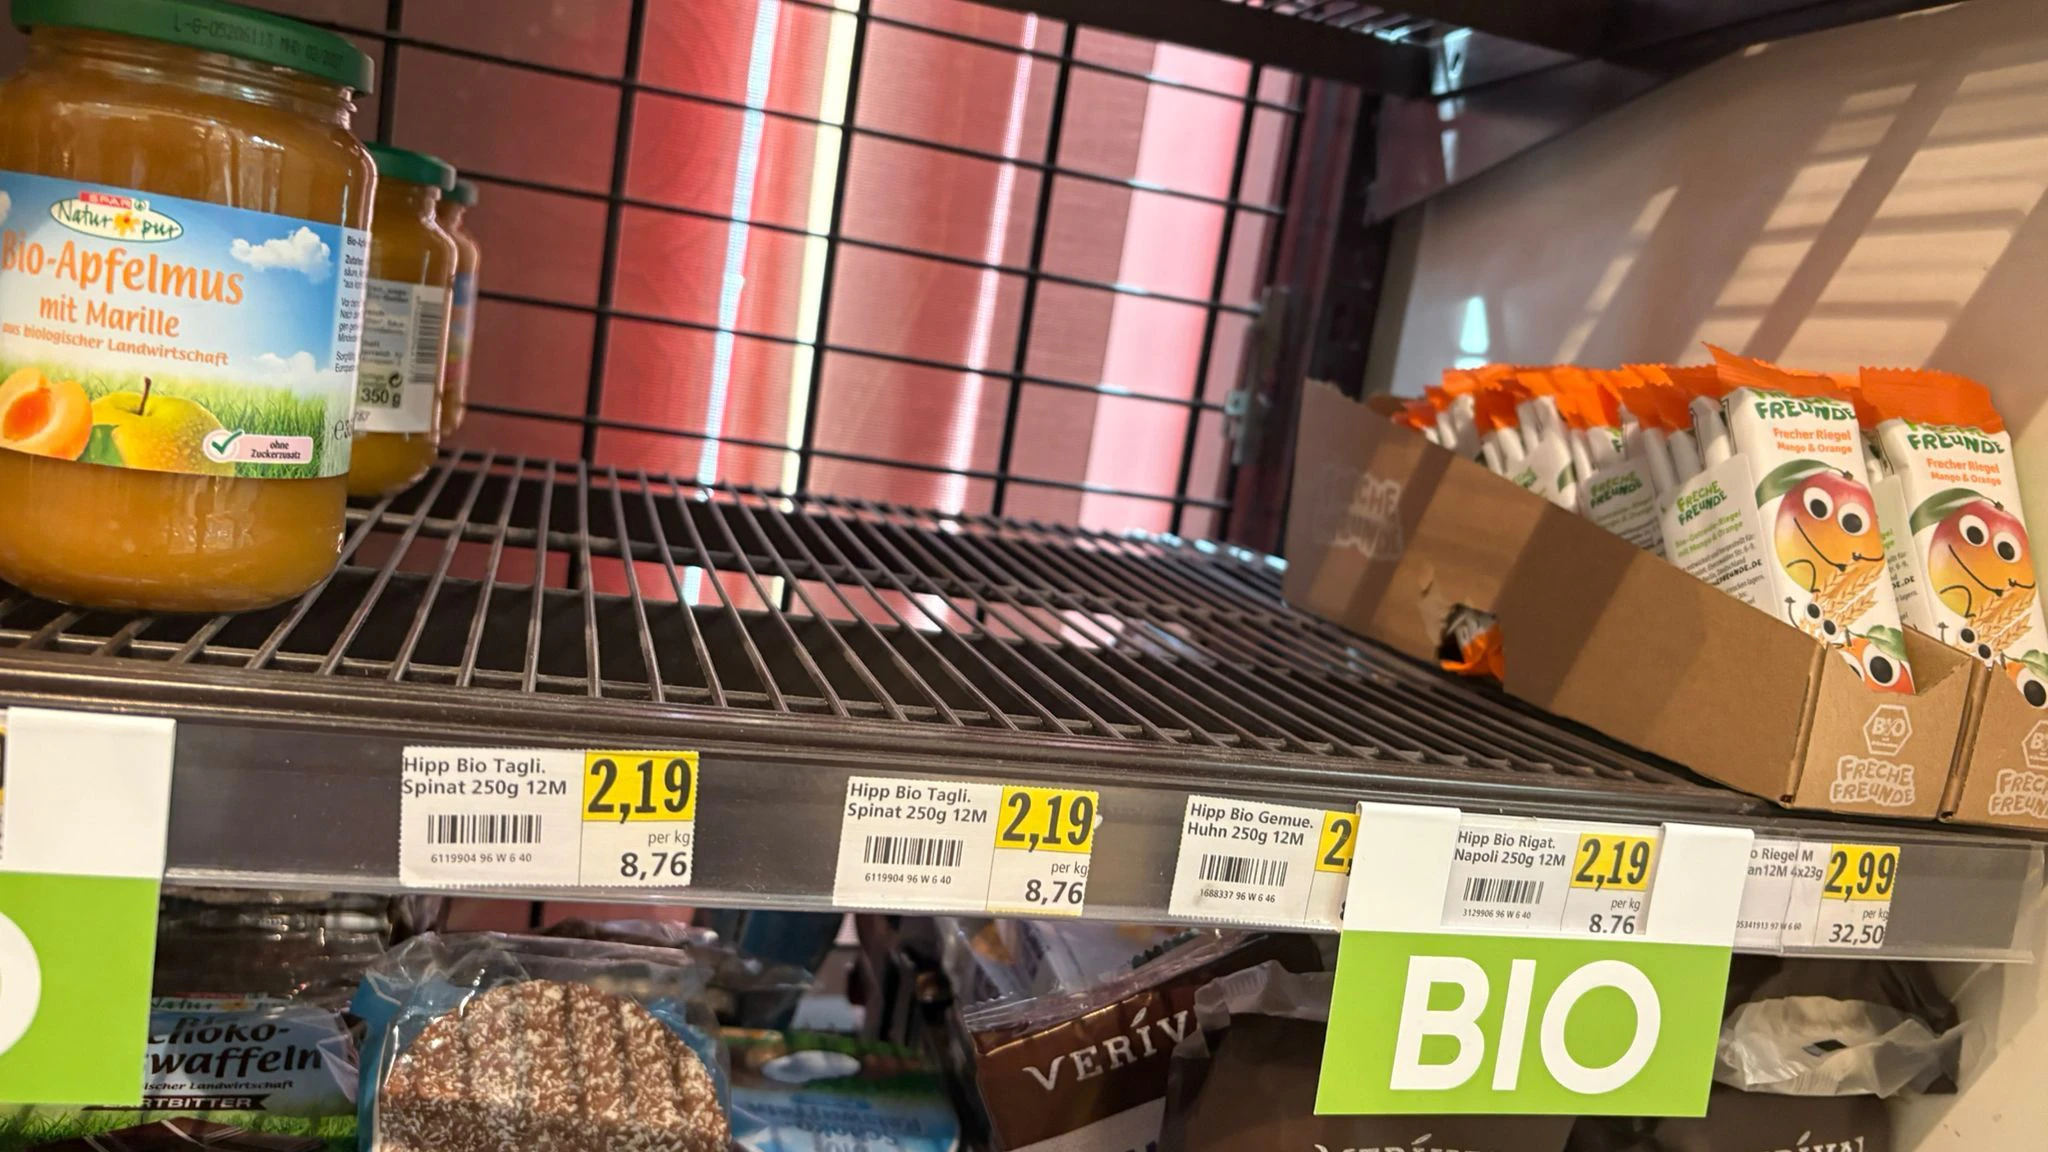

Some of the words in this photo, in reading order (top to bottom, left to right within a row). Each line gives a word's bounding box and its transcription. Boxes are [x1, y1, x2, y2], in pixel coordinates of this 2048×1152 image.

[89, 192, 132, 209] SPAR
[59, 199, 113, 228] Natur
[141, 219, 180, 239] pur
[1, 229, 245, 305] Bio-Apfelmus
[39, 294, 78, 324] mit
[86, 300, 181, 338] Marille
[2, 322, 21, 337] aus
[23, 323, 104, 349] biologischer
[107, 337, 230, 367] Landwirtschaft
[361, 388, 390, 404] 350
[391, 393, 402, 409] g
[1755, 400, 1857, 420] FREUNDE
[269, 440, 289, 450] ohne
[1773, 427, 1813, 440] Frecher
[1815, 429, 1852, 442] Riegel
[1907, 431, 2005, 454] FREUNDE
[251, 449, 301, 460] Zuckerzusatz
[1776, 442, 1806, 453] Mango
[1808, 443, 1815, 452] &
[1817, 444, 1853, 455] Orange
[1926, 458, 1966, 471] Frecher
[1967, 461, 2000, 474] Riegel
[1930, 472, 1960, 483] Mango
[1962, 474, 1969, 482] &
[1970, 474, 2002, 486] Orange
[1676, 480, 1721, 512] FRECHE
[1678, 490, 1728, 526] FREUNDE
[403, 757, 450, 776] Hipp
[457, 757, 487, 774] Bio
[493, 758, 546, 778] Tagli.
[1840, 758, 1912, 787] FRECHE
[402, 779, 466, 796] Spinat
[471, 780, 520, 799] 250g
[526, 780, 567, 795] 12M
[587, 758, 692, 824] 2,19
[851, 783, 891, 801] Hipp
[896, 785, 922, 800] Bio
[928, 787, 971, 805] Tagli.
[1832, 782, 1914, 804] FREUNDE
[847, 803, 902, 820] Spinat
[906, 805, 947, 824] 250g
[953, 808, 987, 824] 12M
[1002, 791, 1094, 852] 2,19
[1190, 803, 1226, 822] Hipp
[1230, 807, 1253, 822] Bio
[1258, 810, 1314, 829] Gemue.
[648, 832, 671, 846] per
[674, 830, 691, 846] kg
[1187, 822, 1227, 838] Huhn
[1231, 826, 1268, 845] 250g
[1273, 830, 1304, 845] 12M
[1457, 831, 1489, 848] Hipp
[1493, 833, 1515, 847] Bio
[1518, 835, 1556, 852] Rigat.
[431, 854, 476, 864] 6119904
[479, 854, 494, 864] 96
[496, 854, 508, 863] W
[511, 854, 517, 863] 6
[518, 853, 532, 863] 40
[620, 852, 688, 880] 8,76
[1454, 848, 1499, 865] Napoli
[1501, 851, 1534, 868] 250g
[1538, 853, 1566, 867] 12M
[1575, 838, 1651, 892] 2,19
[1761, 847, 1799, 864] Riegel
[1802, 850, 1814, 861] M
[865, 872, 905, 883] 6119904
[906, 874, 918, 884] 96
[920, 874, 930, 884] W
[932, 875, 938, 884] 6
[939, 875, 952, 885] 40
[1050, 862, 1071, 876] per
[1073, 862, 1088, 878] kg
[1747, 864, 1788, 877] an12M
[1790, 865, 1823, 881] 4x23g
[1824, 851, 1896, 902] 2,99
[1025, 879, 1083, 906] 8,76
[1199, 888, 1233, 900] 1688337
[1236, 891, 1246, 901] 96
[1247, 892, 1257, 902] W
[1258, 893, 1263, 902] 6
[1265, 894, 1276, 903] 46
[1462, 908, 1494, 918] 3129906
[1495, 910, 1505, 918] 96
[1506, 910, 1514, 919] W
[1515, 911, 1520, 919] 6
[1522, 911, 1531, 919] 40
[1610, 899, 1628, 911] per
[1629, 897, 1641, 912] kg
[1862, 909, 1877, 921] per
[1878, 908, 1889, 921] kg
[1828, 924, 1885, 946] 32,50
[1390, 955, 1661, 1094] BIO
[190, 1080, 293, 1091] Landwirtschaft
